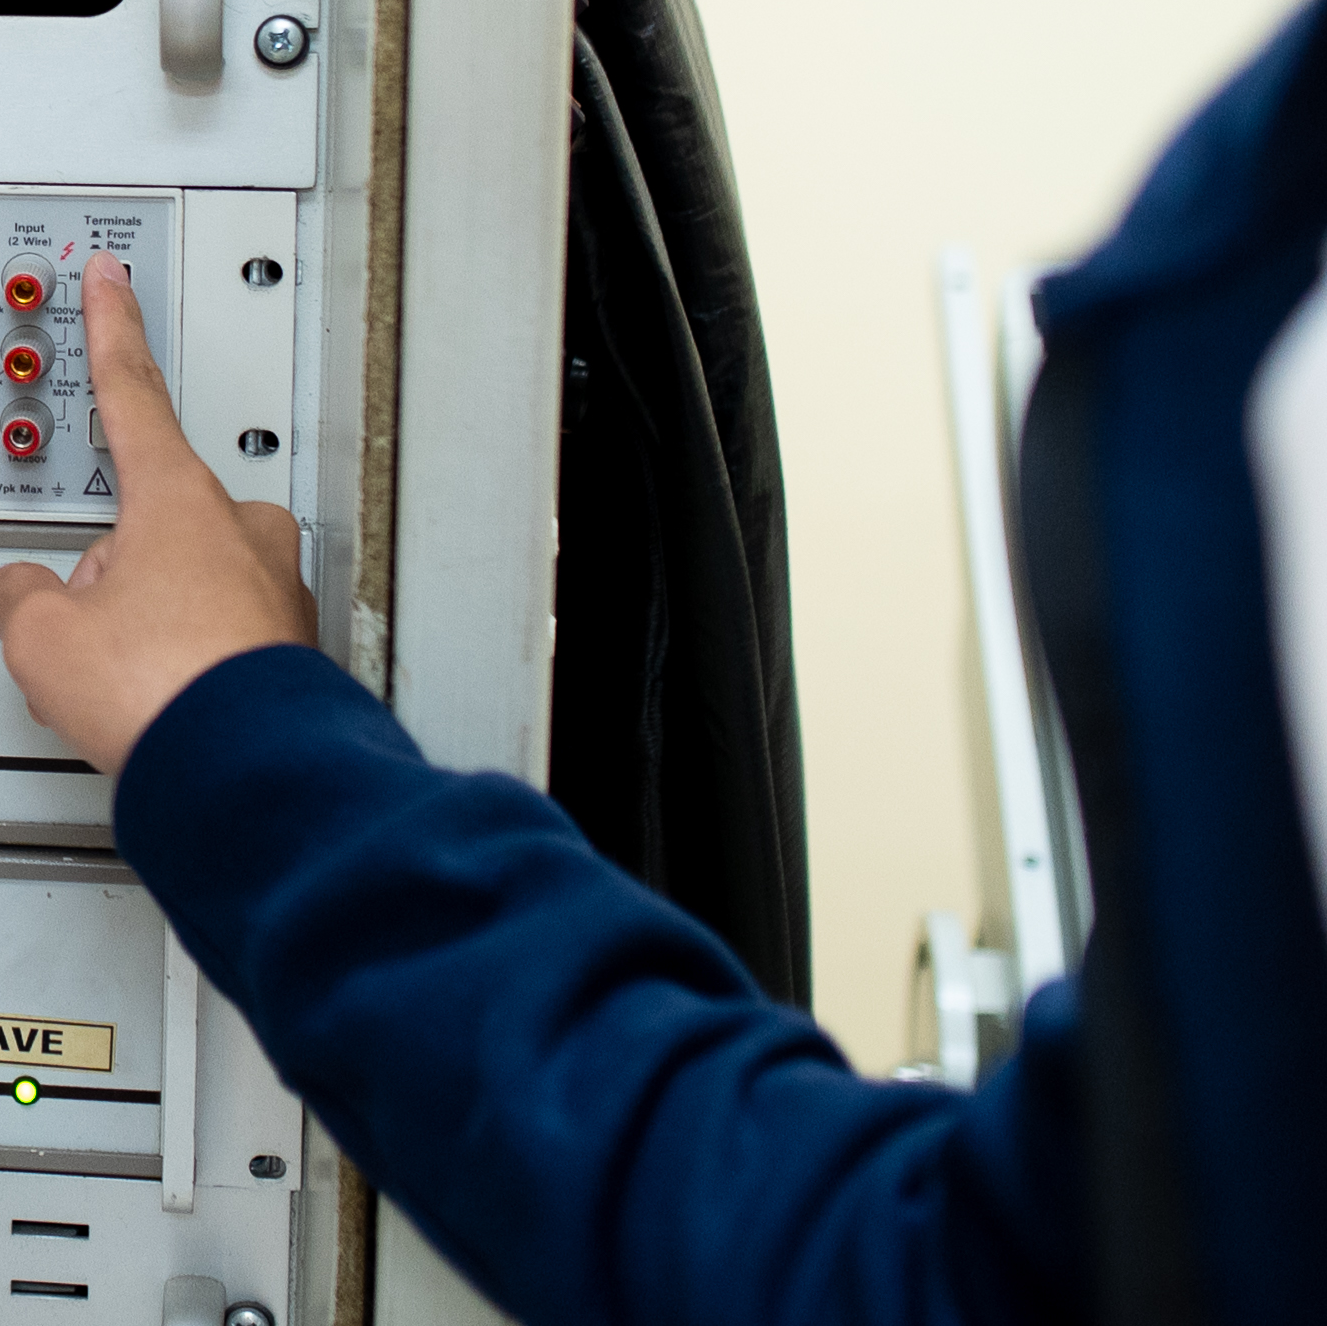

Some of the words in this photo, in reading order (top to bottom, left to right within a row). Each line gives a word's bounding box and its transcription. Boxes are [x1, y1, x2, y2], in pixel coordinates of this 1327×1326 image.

[84, 216, 142, 227] Terminals
[14, 223, 45, 234] Input
[107, 230, 135, 239] Front
[24, 237, 52, 247] Wire)
[107, 241, 131, 250] Rear
[54, 316, 77, 325] MAX
[53, 388, 76, 397] MAX
[20, 484, 43, 494] Max
